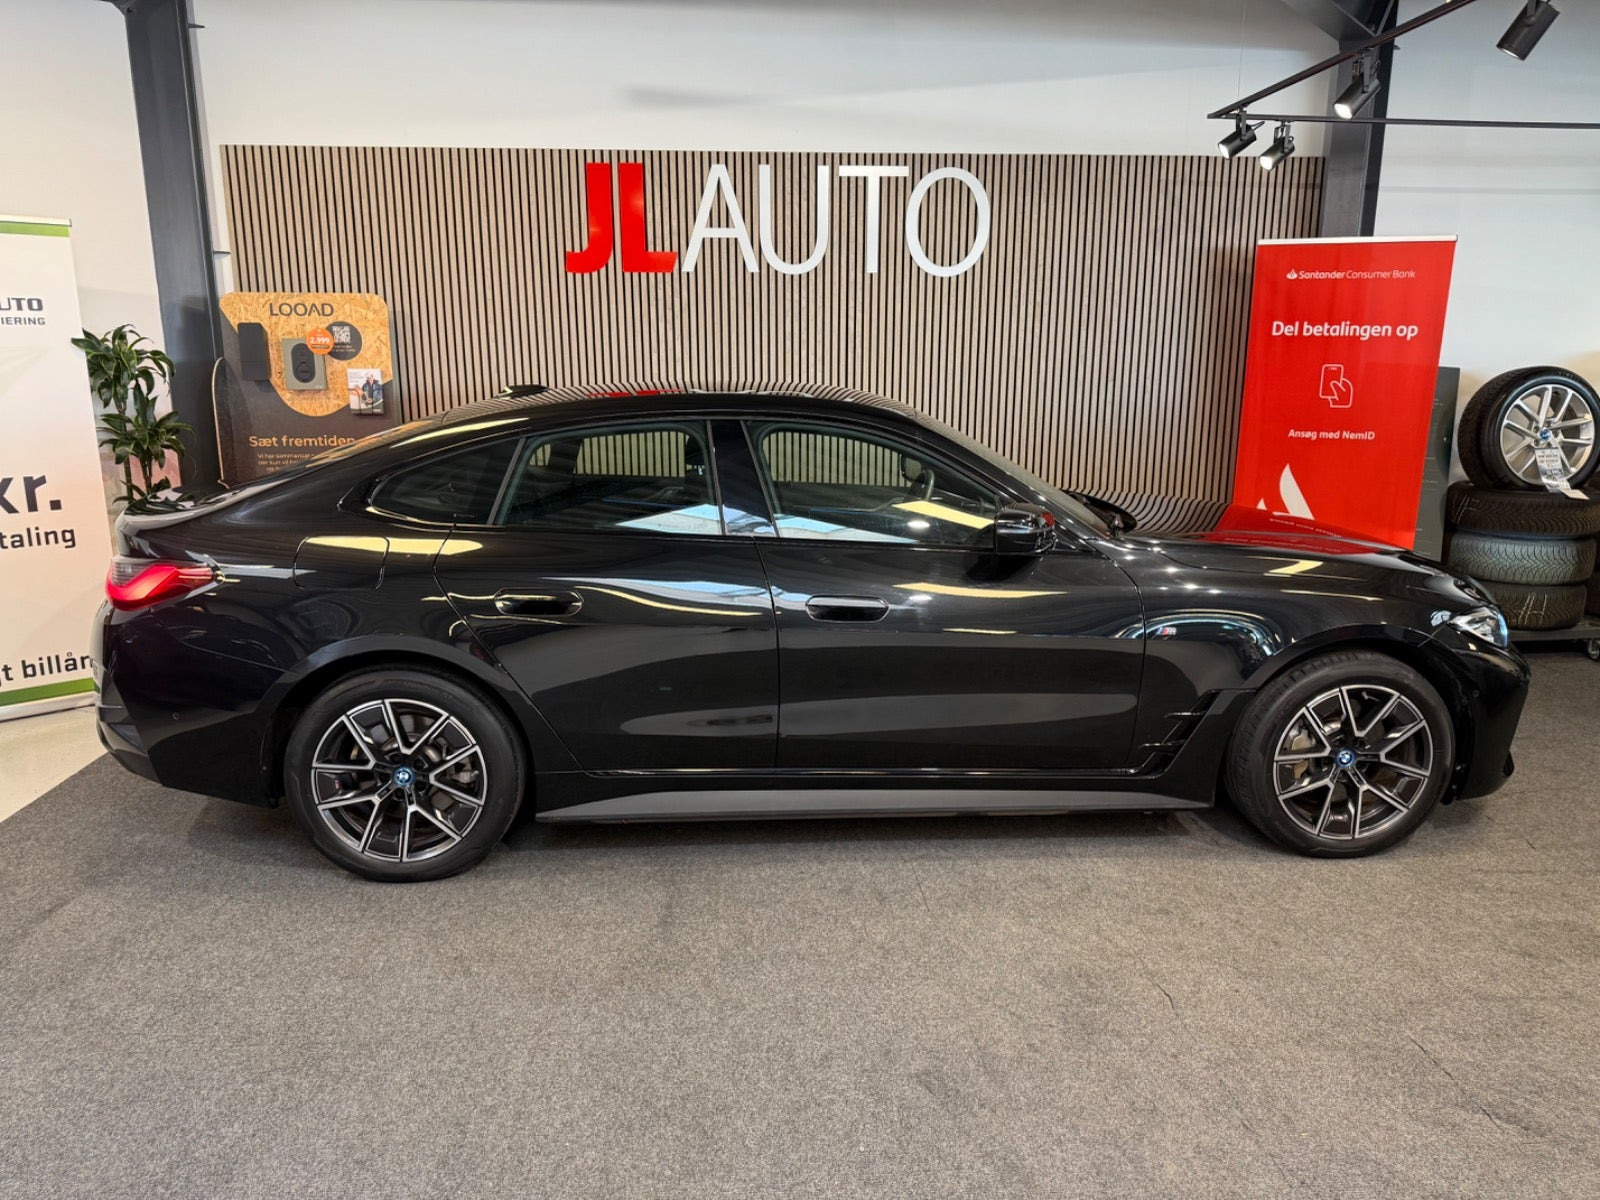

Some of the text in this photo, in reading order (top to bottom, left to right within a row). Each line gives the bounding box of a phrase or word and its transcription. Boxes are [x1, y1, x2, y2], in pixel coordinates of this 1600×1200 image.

[1299, 269, 1416, 280] Santander Consumer Bank
[269, 302, 334, 317] LOOAD
[1272, 321, 1418, 341] Del betalingen op
[1288, 428, 1376, 440] Ansøg med NemID
[249, 435, 279, 447] Sæt
